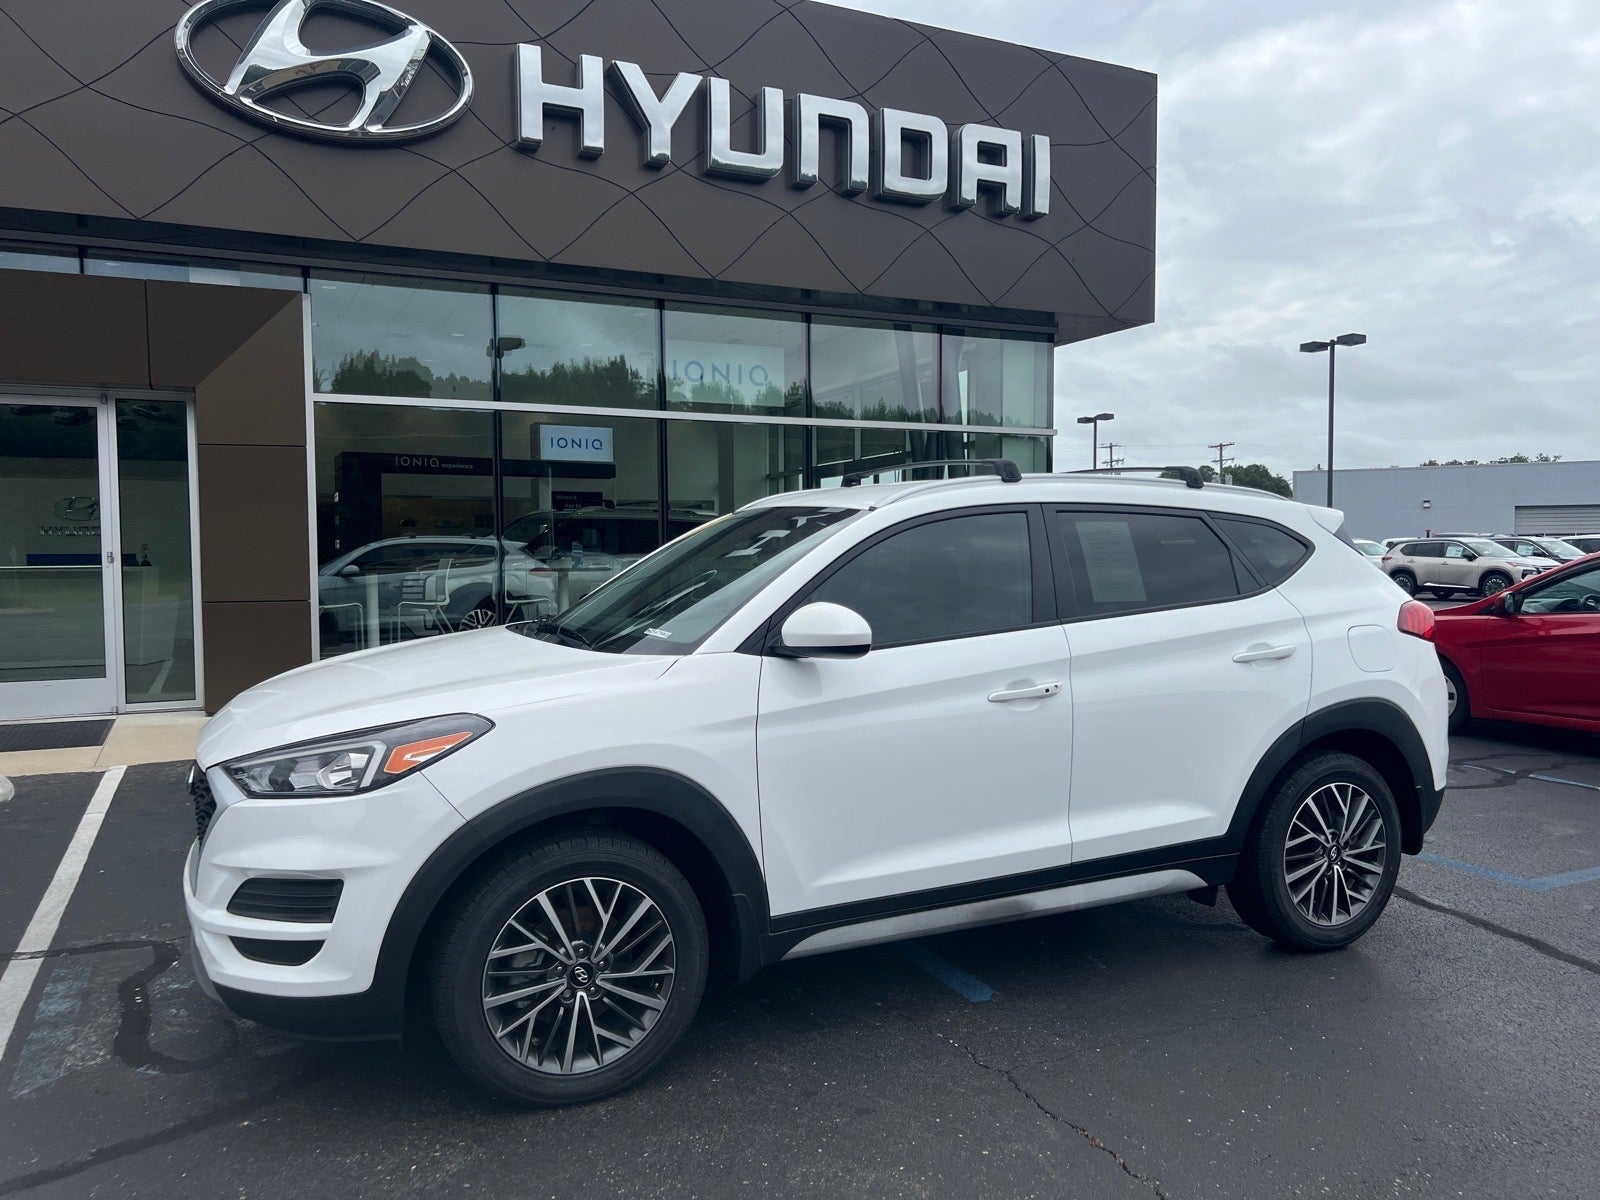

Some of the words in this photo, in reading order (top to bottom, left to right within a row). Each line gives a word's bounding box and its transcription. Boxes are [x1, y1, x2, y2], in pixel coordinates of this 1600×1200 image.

[516, 42, 1051, 219] HYUNDAI
[673, 359, 769, 387] IONIQ
[550, 436, 603, 451] IONIQ
[395, 455, 439, 468] IONIQ
